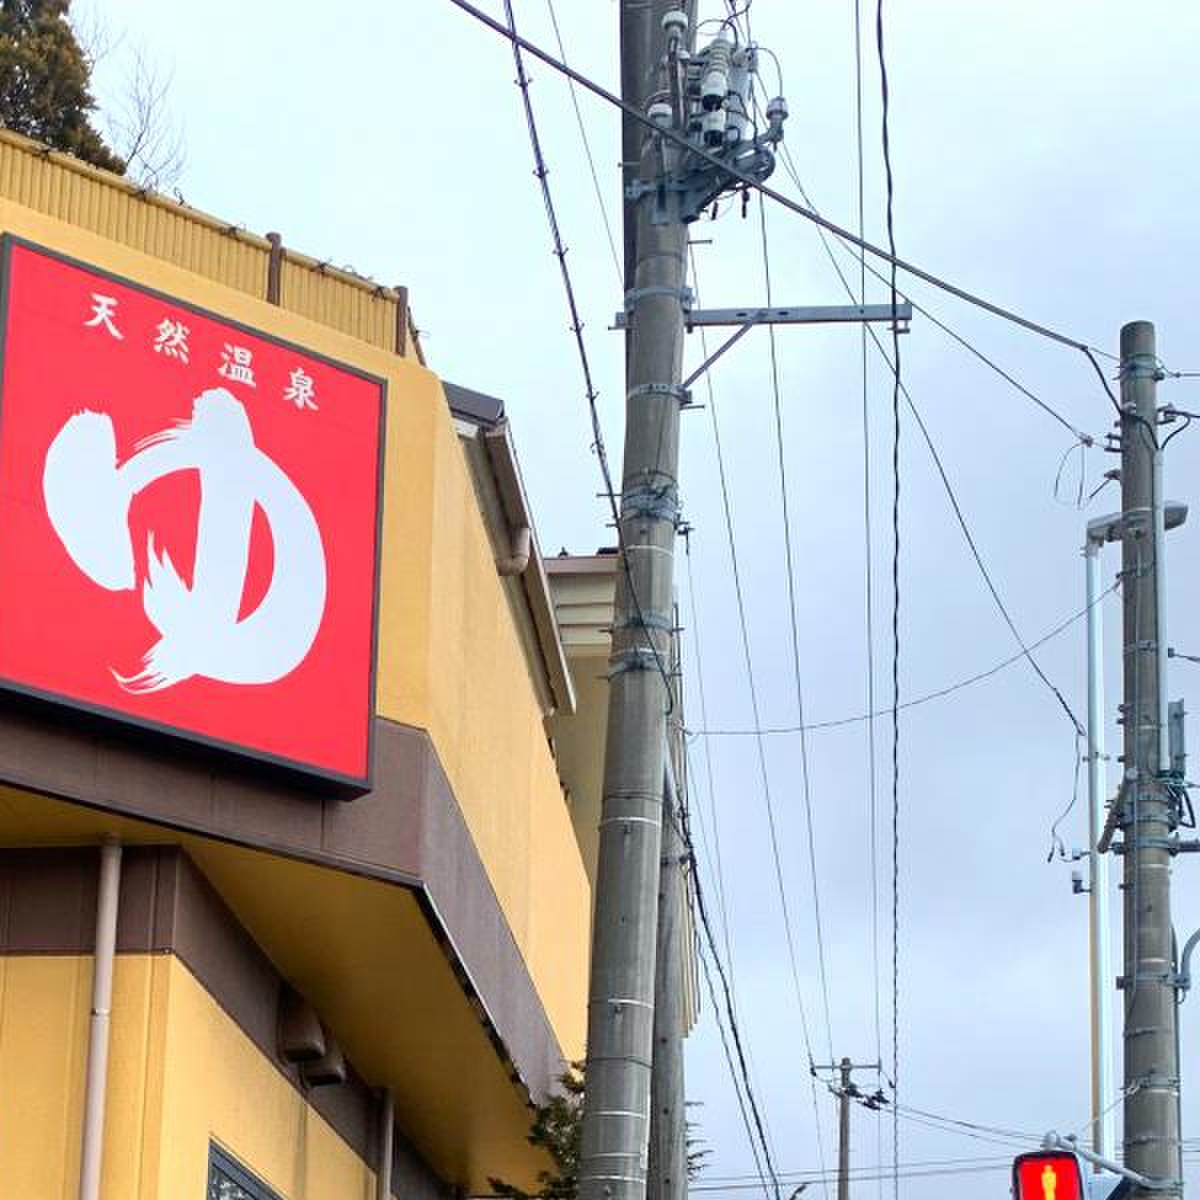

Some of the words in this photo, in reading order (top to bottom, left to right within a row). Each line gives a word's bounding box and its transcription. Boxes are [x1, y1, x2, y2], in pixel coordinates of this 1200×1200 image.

[84, 292, 319, 411] 天然温泉
[42, 386, 328, 696] ゆ
